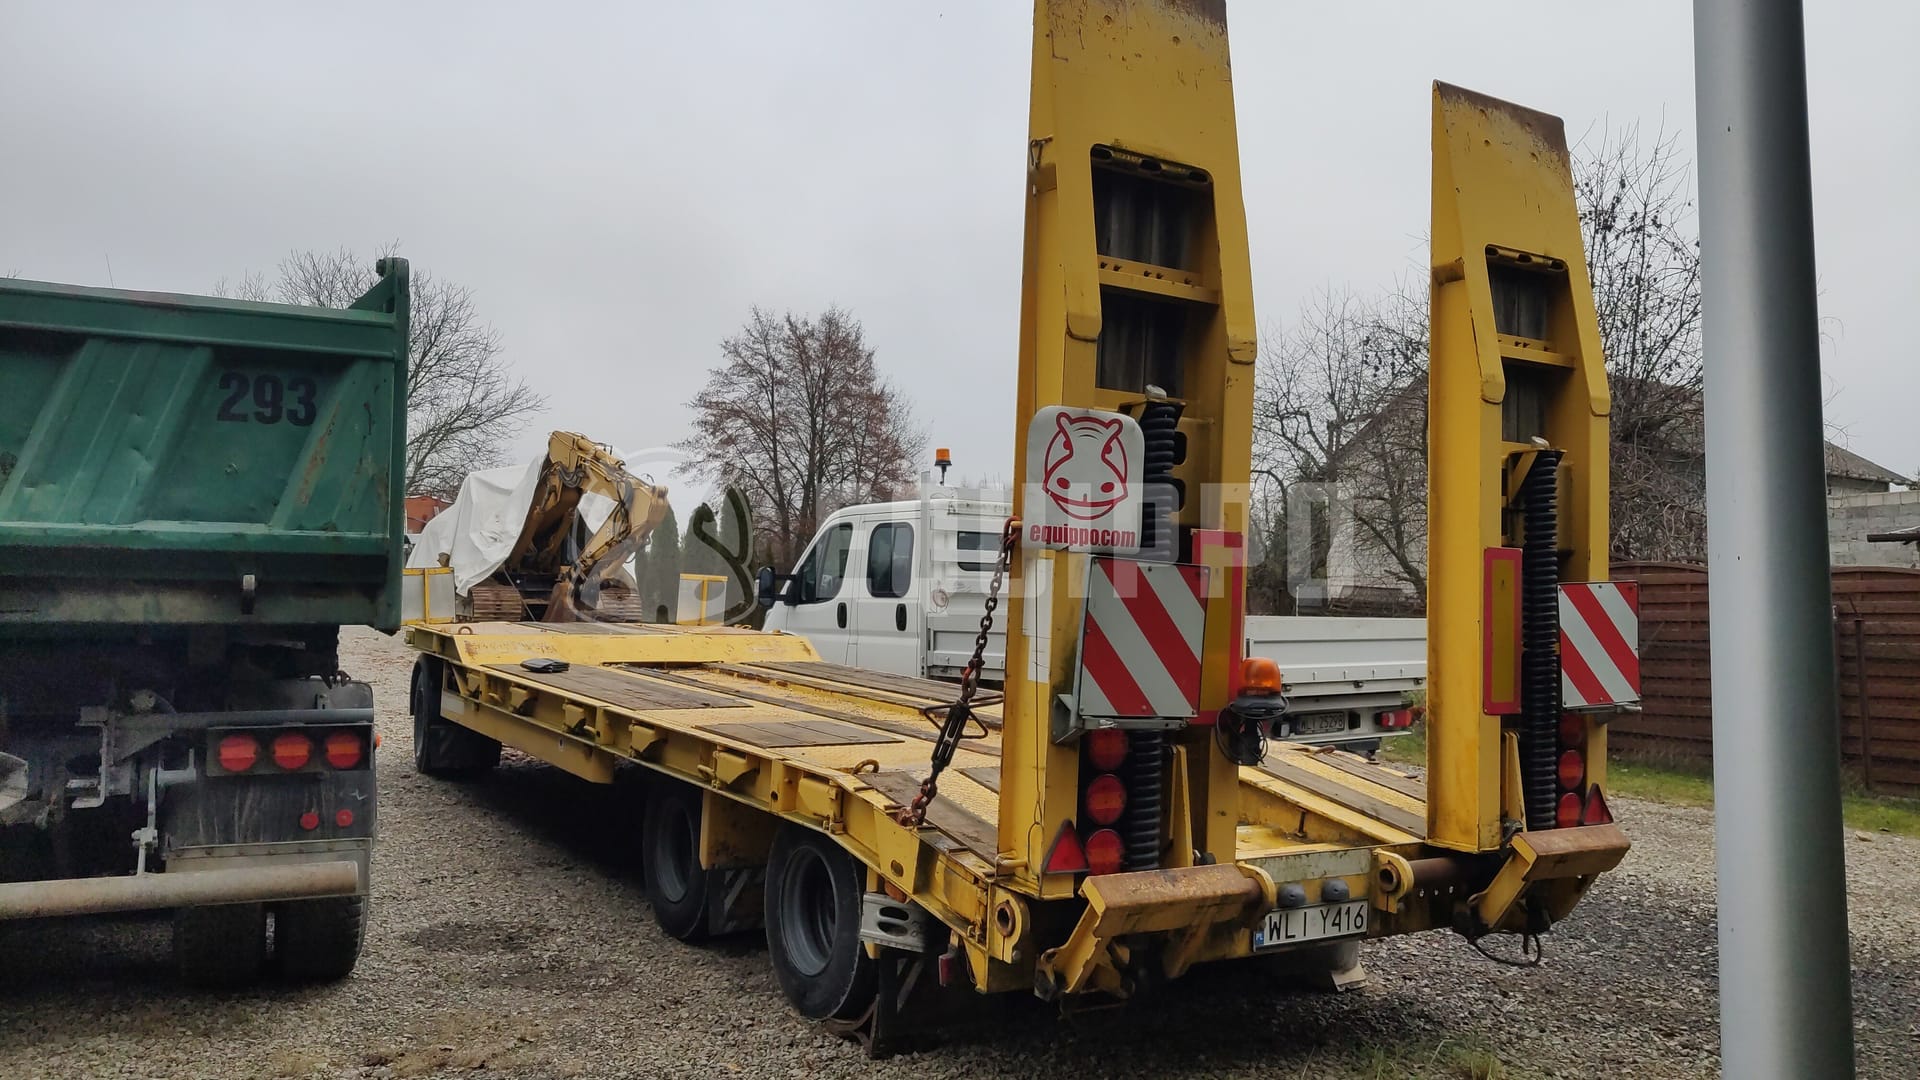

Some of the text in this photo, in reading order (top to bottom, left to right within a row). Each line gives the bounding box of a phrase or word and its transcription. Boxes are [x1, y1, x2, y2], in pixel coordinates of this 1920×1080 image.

[217, 371, 317, 428] 293
[1029, 523, 1136, 548] equippo.com
[1319, 904, 1365, 935] Y416
